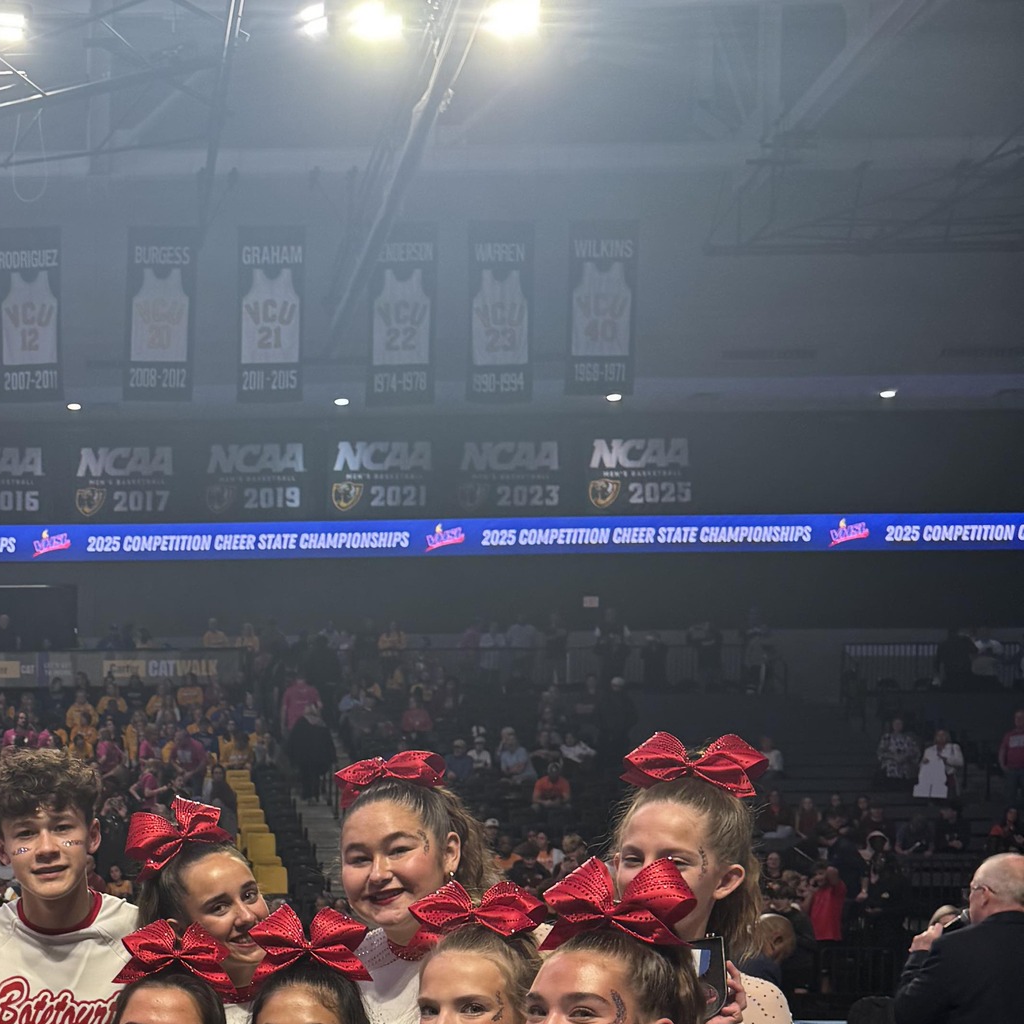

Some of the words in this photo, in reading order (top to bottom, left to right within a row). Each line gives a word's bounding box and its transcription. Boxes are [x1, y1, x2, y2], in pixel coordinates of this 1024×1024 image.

[134, 246, 190, 265] BURGESS
[242, 246, 303, 265] GRAHAM
[475, 243, 525, 262] WARREN
[574, 240, 634, 259] WILKINS
[4, 303, 54, 328] VCU
[244, 300, 297, 326] VCU
[20, 328, 39, 351] 12
[257, 326, 281, 350] 21
[385, 328, 416, 351] 22
[3, 370, 58, 391] 2007-2011
[129, 368, 186, 388] 2008-2012
[242, 370, 298, 391] 2011-2015
[76, 447, 174, 477] NCAA
[206, 443, 305, 473] NCAA
[333, 441, 432, 471] NCAA
[460, 441, 560, 471] NCAA
[589, 438, 690, 469] NCAA
[113, 490, 170, 512] 2017
[244, 487, 301, 508] 2019
[370, 485, 425, 507] 2021
[497, 485, 560, 506] 2023
[628, 481, 692, 504] 2025
[87, 536, 121, 552] 2025
[123, 535, 212, 552] COMPETITION
[214, 533, 254, 550] CHEER
[258, 533, 297, 550] STATE
[299, 531, 410, 550] CHAMPIONSHIPS
[481, 529, 517, 546] 2025
[518, 527, 611, 546] COMPETITION
[612, 526, 655, 545] CHEER
[656, 526, 698, 544] STATE
[699, 525, 812, 543] CHAMPIONSHIPS
[885, 525, 920, 542] 2025
[923, 524, 1017, 542] COMPETITION
[21, 665, 34, 673] CAT
[148, 660, 218, 677] CATWALK
